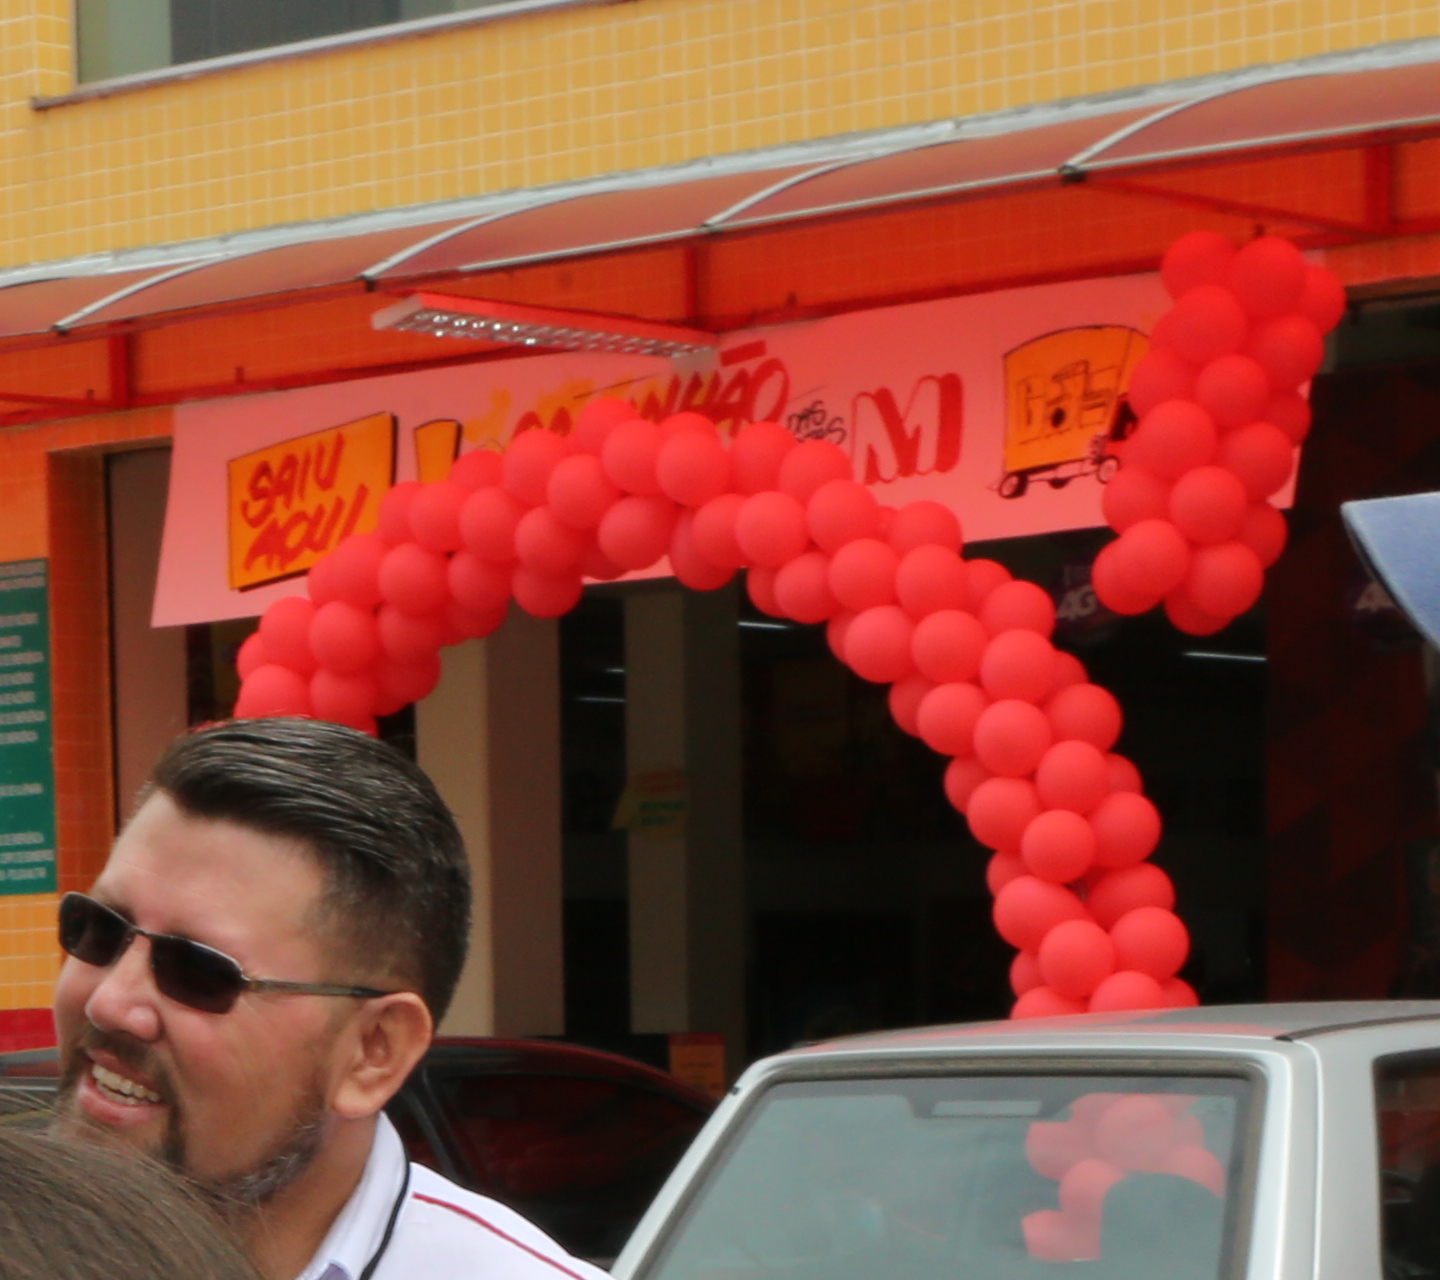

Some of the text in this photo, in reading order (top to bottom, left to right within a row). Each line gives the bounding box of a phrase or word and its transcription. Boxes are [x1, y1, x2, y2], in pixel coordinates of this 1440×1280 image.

[851, 372, 963, 485] M
[241, 431, 345, 529] SAIU
[243, 483, 370, 572] AQUI
